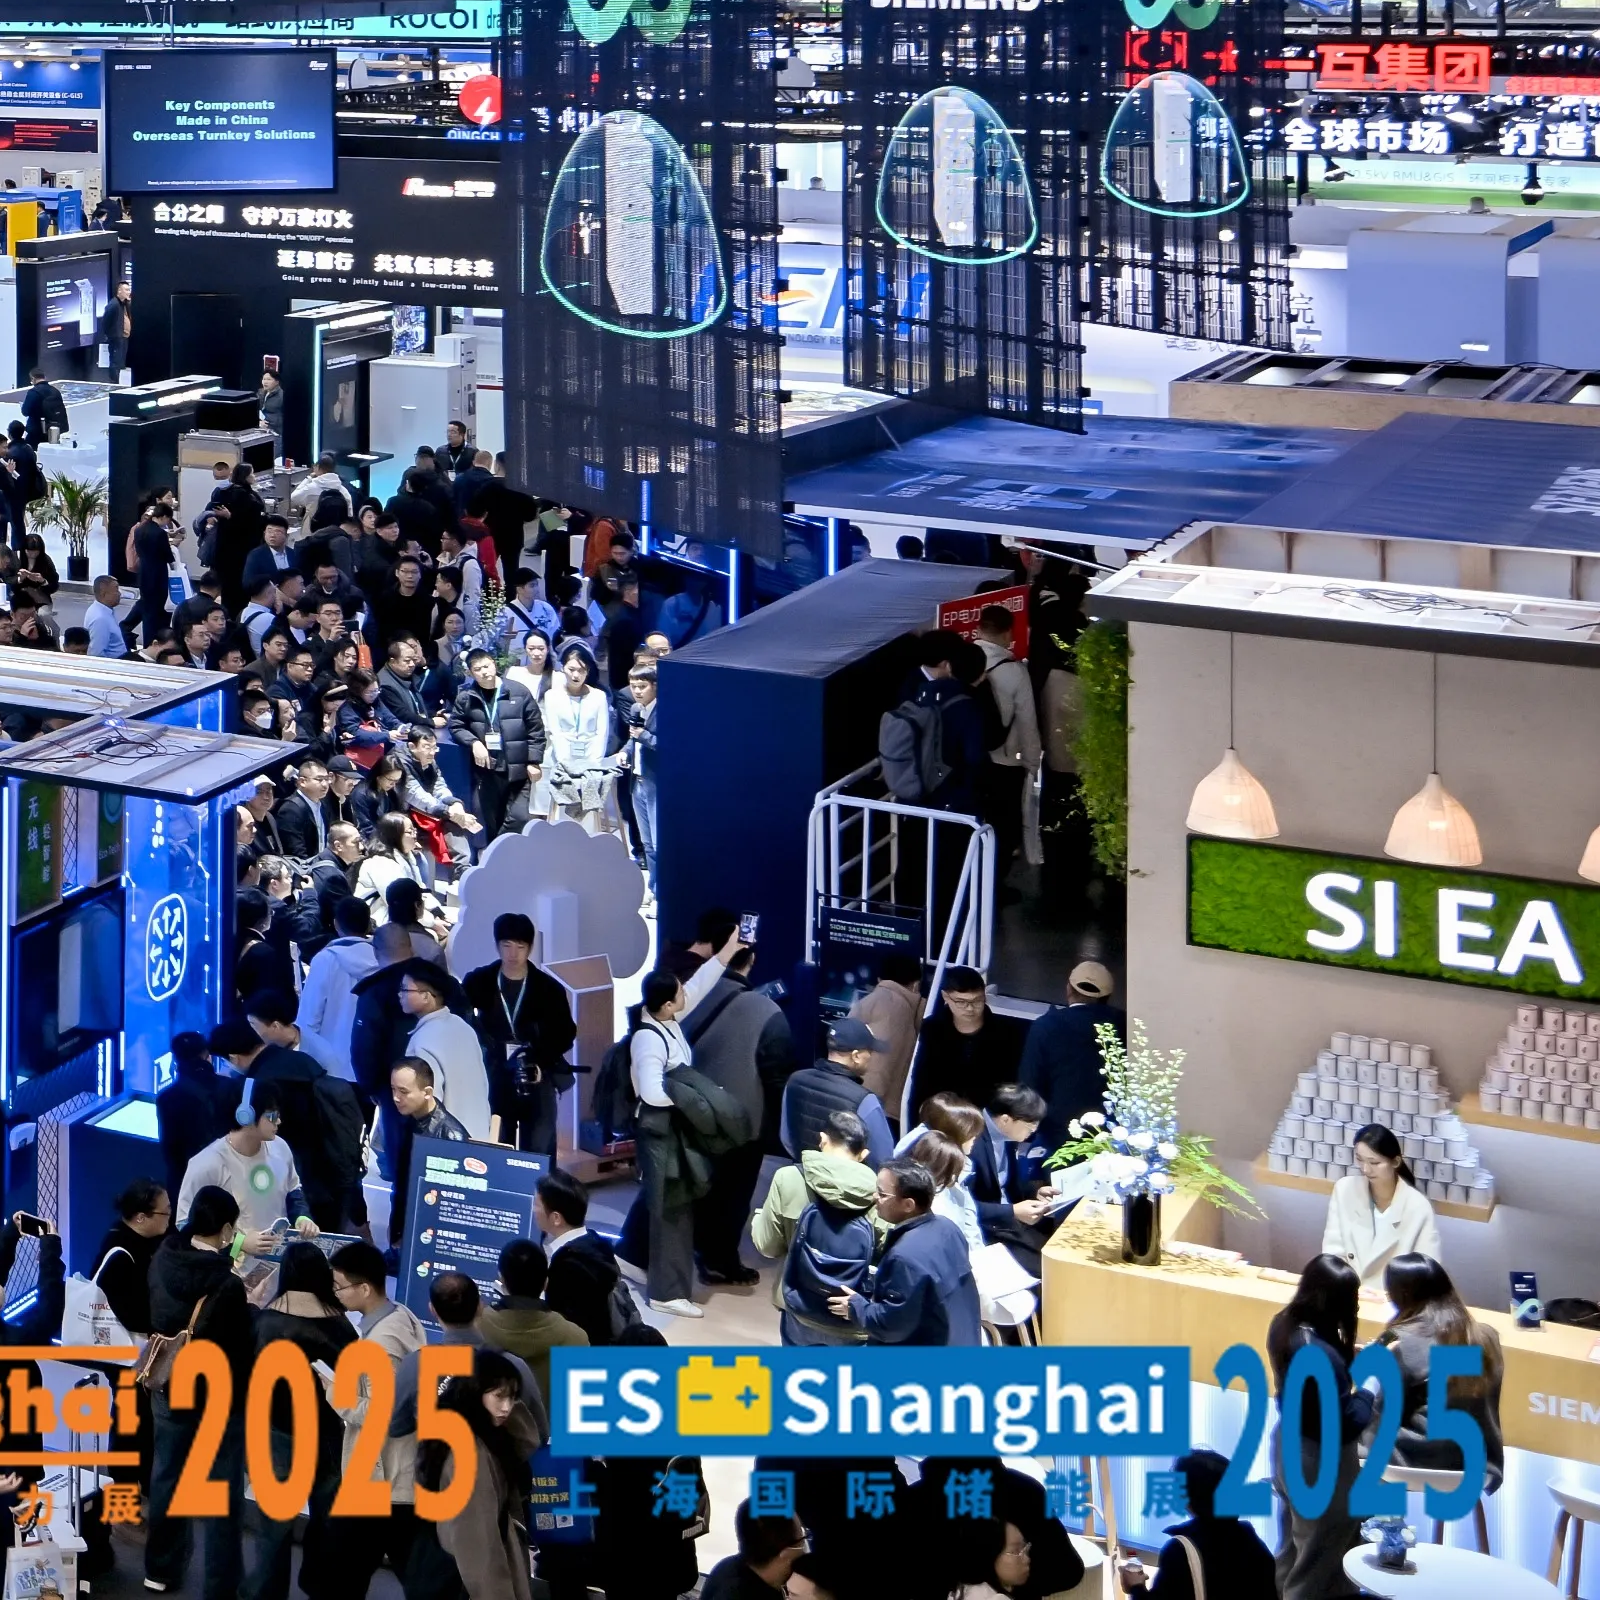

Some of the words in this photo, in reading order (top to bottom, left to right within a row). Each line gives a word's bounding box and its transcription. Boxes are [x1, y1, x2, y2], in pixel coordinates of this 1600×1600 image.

[165, 100, 191, 112] Key
[195, 100, 275, 112] Components
[176, 115, 211, 126] Made
[215, 115, 228, 126] in
[232, 115, 268, 126] China
[133, 130, 194, 141] Overseas
[198, 130, 251, 142] Turnkey
[254, 129, 316, 141] Solutions
[1282, 119, 1450, 155] 全球市场
[1499, 123, 1600, 158] 打造
[282, 274, 304, 284] Going
[310, 276, 332, 285] green
[338, 276, 347, 284] to
[353, 277, 379, 287] jointly
[383, 278, 404, 287] build
[421, 280, 467, 290] low-carbon
[472, 282, 500, 292] future
[506, 1158, 541, 1171] SIEMENS
